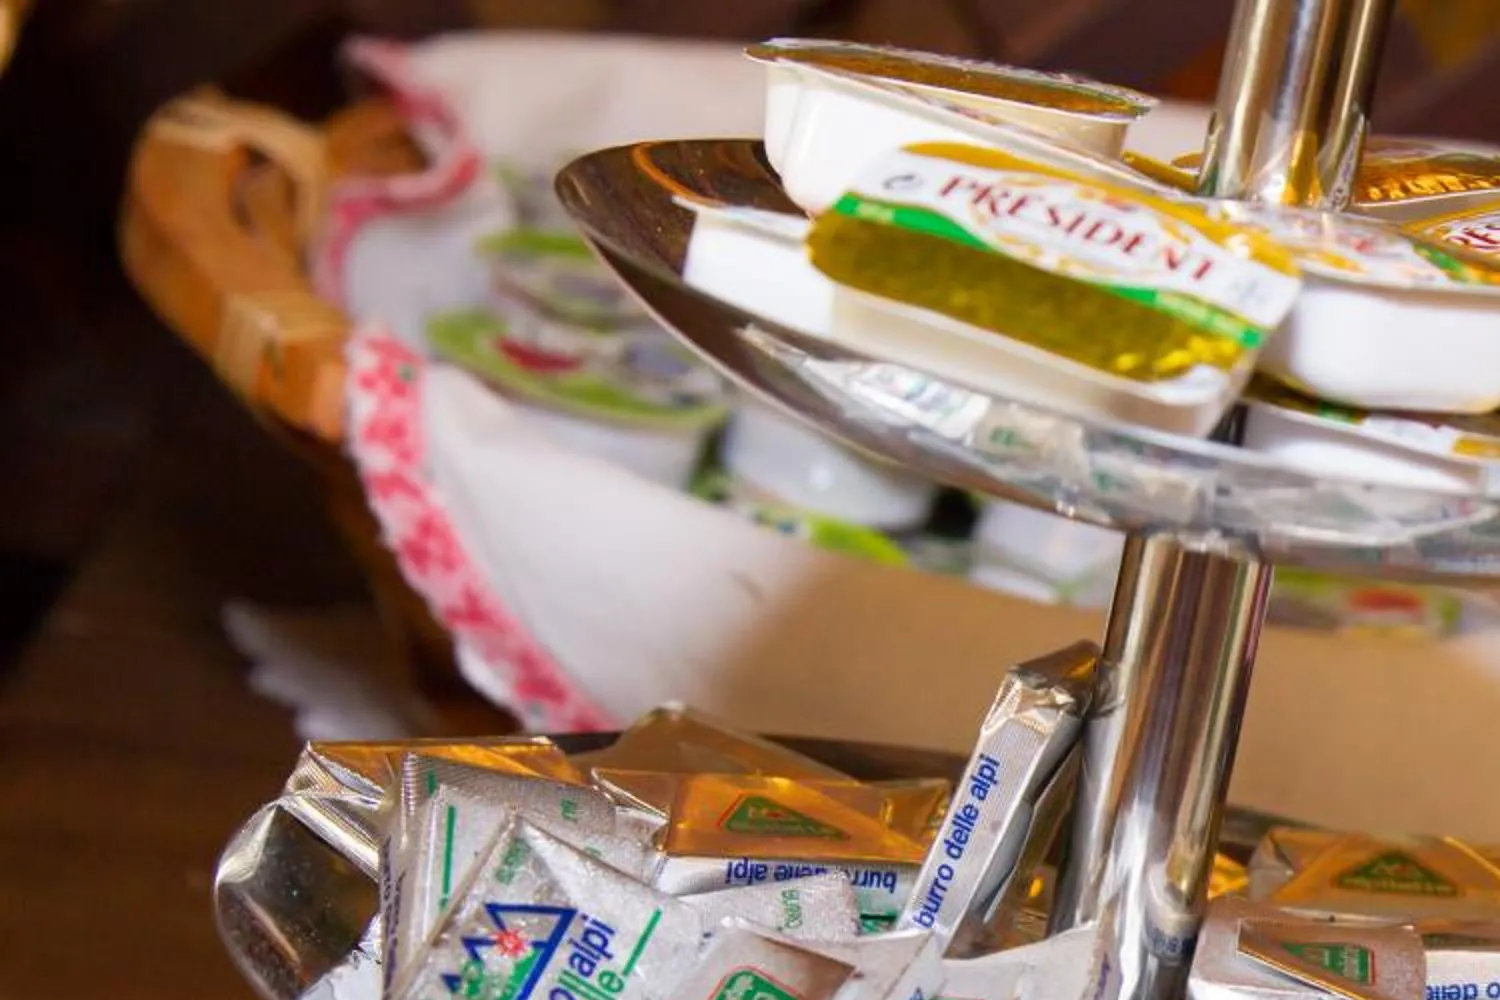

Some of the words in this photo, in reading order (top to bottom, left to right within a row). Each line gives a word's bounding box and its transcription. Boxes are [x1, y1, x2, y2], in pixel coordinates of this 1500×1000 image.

[913, 863, 955, 928] burro
[944, 804, 979, 860] delle
[970, 753, 1000, 801] alpi
[726, 857, 768, 885] alpi
[845, 870, 897, 894] burr
[568, 912, 616, 979] alpi
